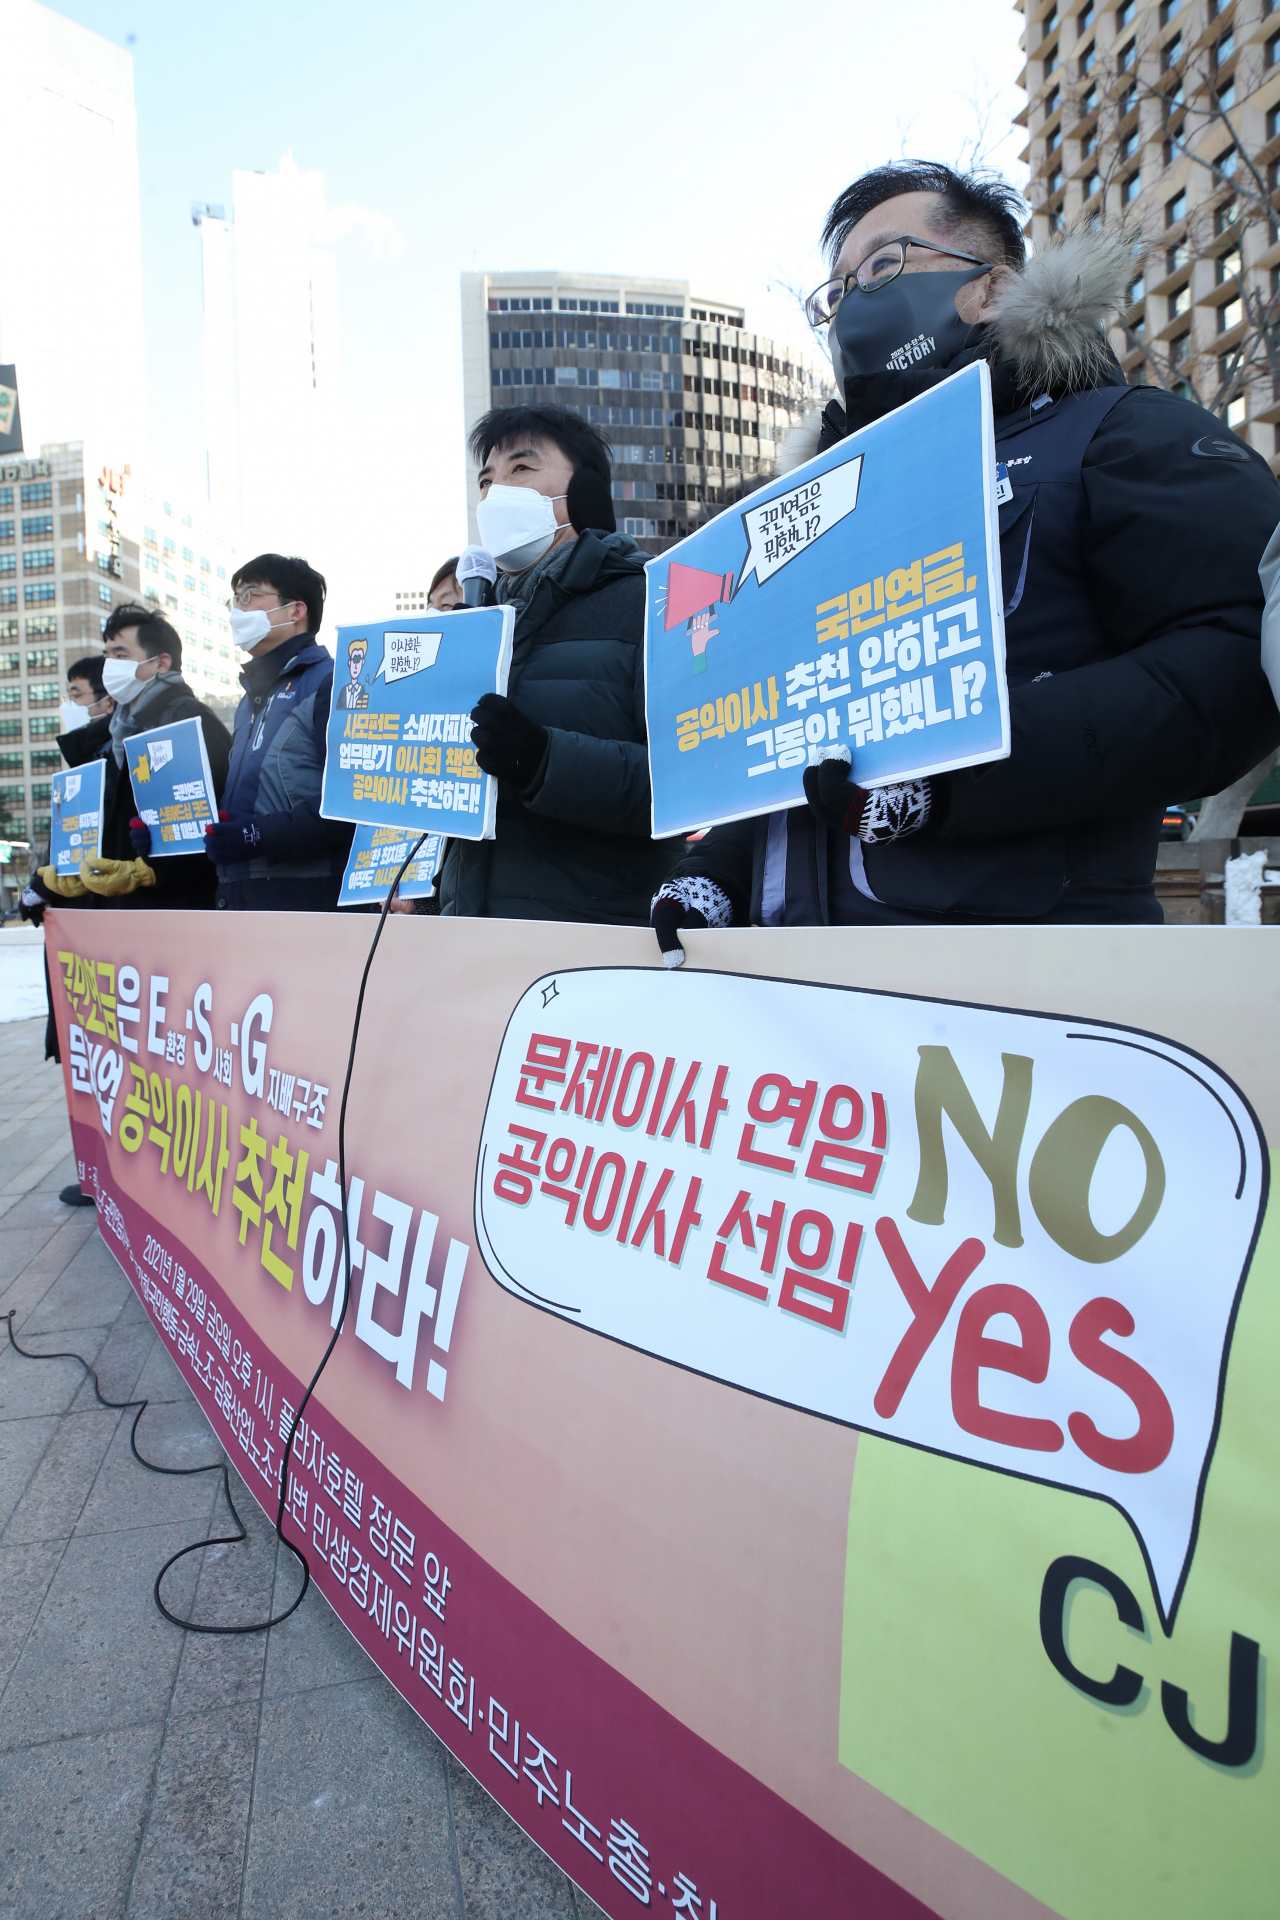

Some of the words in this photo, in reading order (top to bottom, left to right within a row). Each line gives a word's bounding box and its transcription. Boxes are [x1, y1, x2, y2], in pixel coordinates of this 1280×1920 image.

[886, 336, 936, 370] VICTORY
[759, 482, 822, 536] 국민연금은
[764, 515, 821, 563] 뭐했나?
[816, 541, 977, 644] 국민연금,
[390, 655, 421, 673] 뭐했나?
[391, 636, 421, 653] 이사회는
[676, 675, 780, 752] 공익이사
[785, 646, 851, 711] 추천
[859, 597, 981, 688] 안하고
[343, 713, 400, 740] 사모펀드
[746, 706, 841, 777] 그동안
[848, 660, 987, 748] 뭐했나?
[339, 743, 393, 772] 업무방기
[395, 745, 441, 776] 이사회
[159, 802, 193, 823] 스튜어드십
[192, 800, 211, 818] 코드
[172, 780, 206, 801] 국민연금!
[353, 774, 408, 805] 공익이사
[410, 778, 482, 814] 추천하라!
[348, 870, 375, 890] 아직도
[515, 1032, 729, 1149] 문제이사
[737, 1072, 888, 1194] 연임
[906, 1044, 1167, 1265] NO
[118, 1060, 230, 1217] 공익이사
[231, 1116, 470, 1401] 추천하라!
[493, 1123, 702, 1264] 공익이사
[707, 1189, 865, 1333] 선임
[873, 1215, 1175, 1474] Yes
[143, 1234, 173, 1284] 2021년
[172, 1262, 186, 1300] 1월
[185, 1278, 207, 1326] 29일
[206, 1301, 232, 1363] 금요일
[231, 1339, 253, 1390] 오후
[278, 1397, 364, 1530] 플라자호텔
[368, 1494, 416, 1586] 정문
[423, 1552, 452, 1622] 앞
